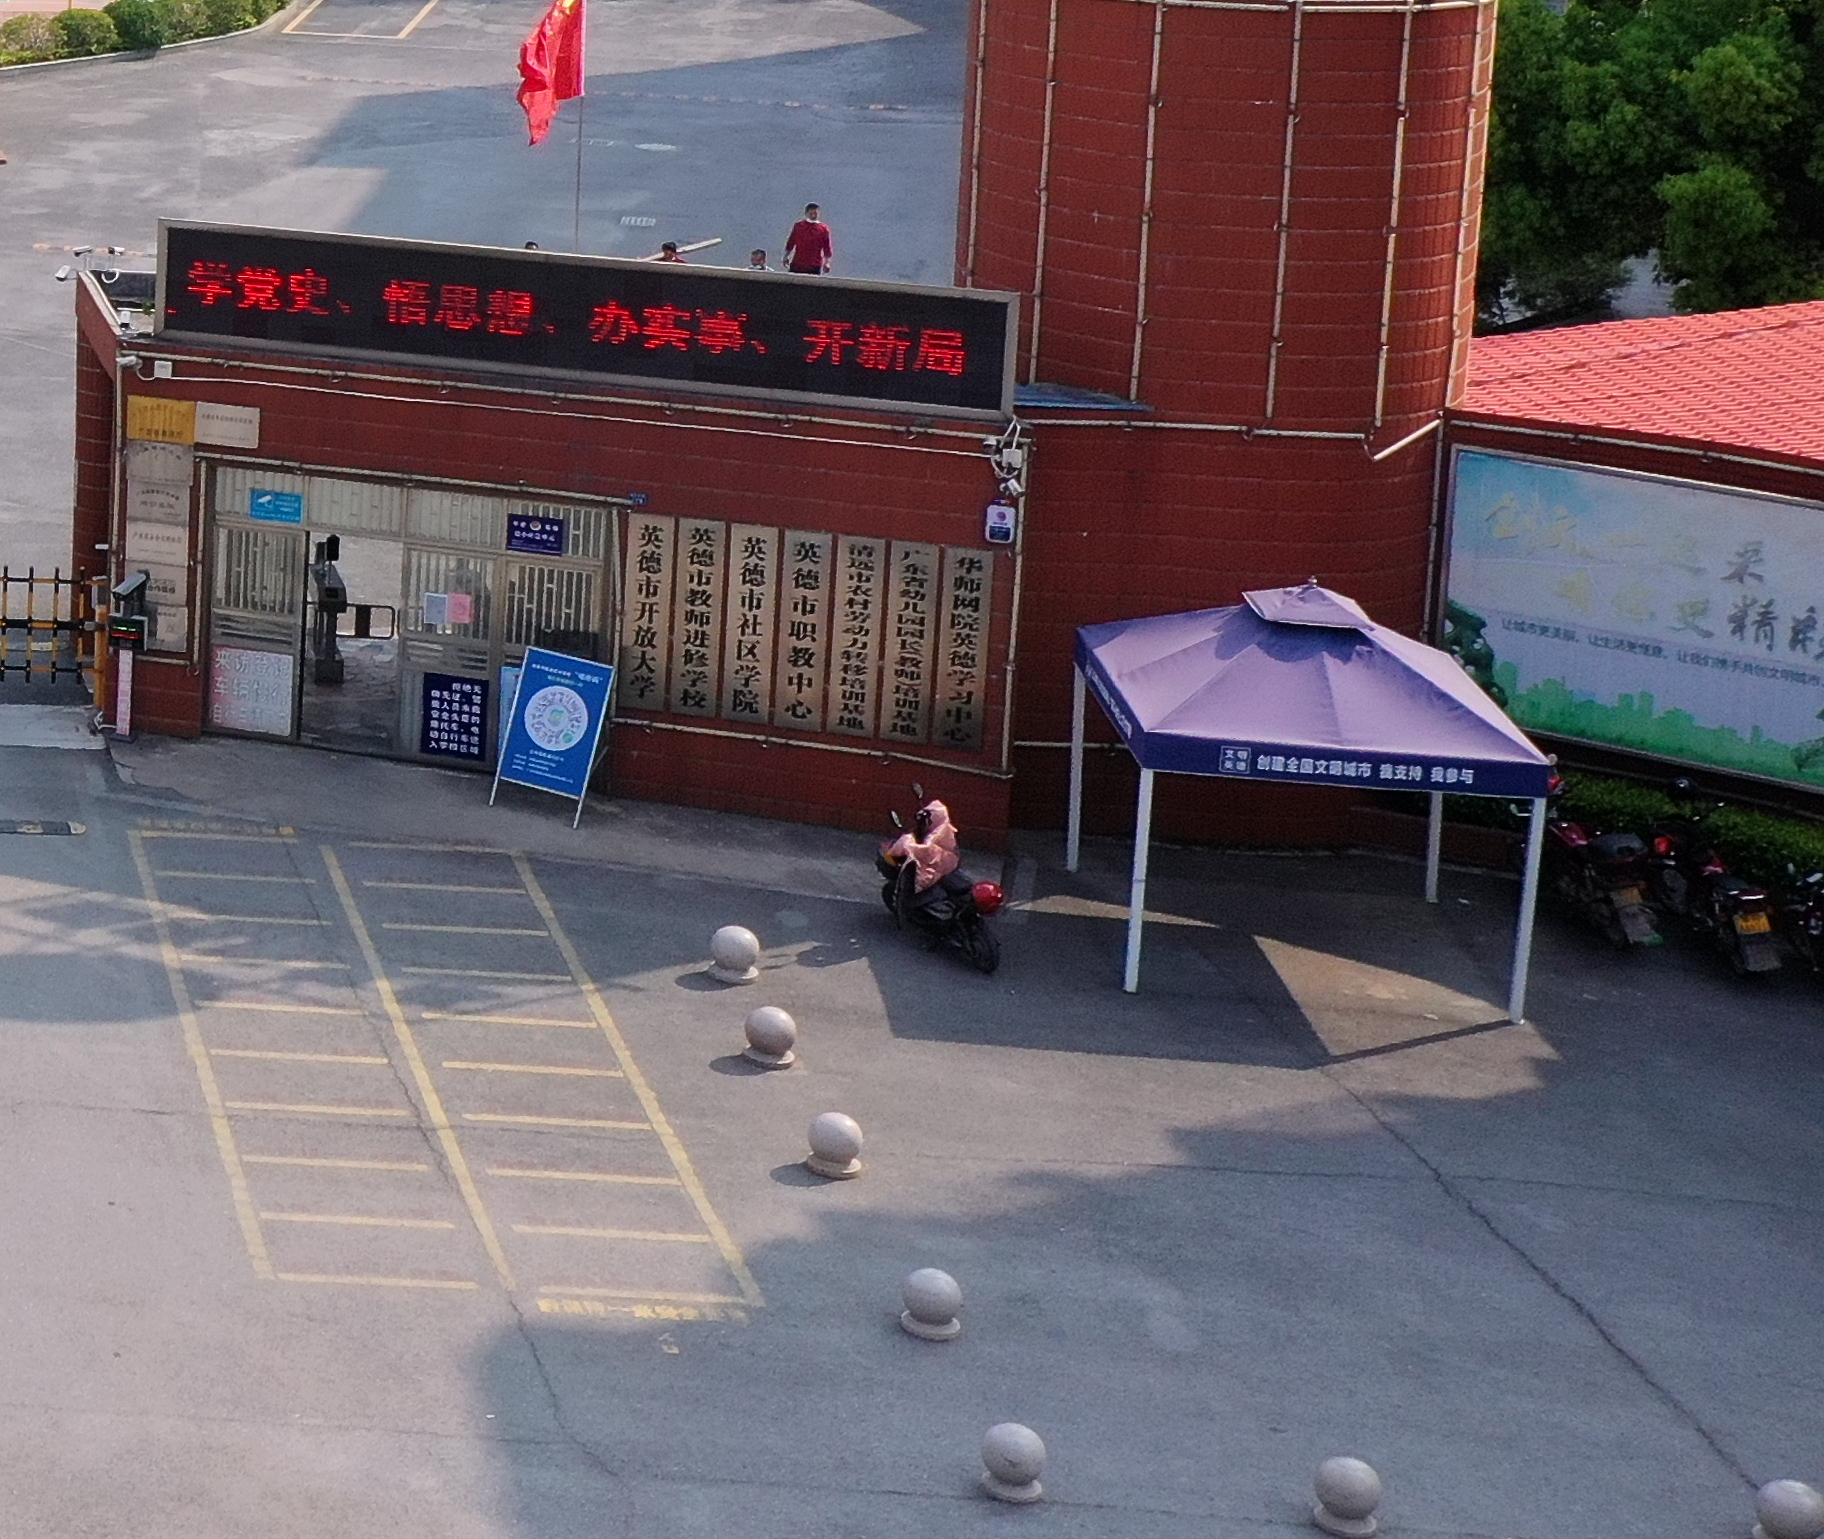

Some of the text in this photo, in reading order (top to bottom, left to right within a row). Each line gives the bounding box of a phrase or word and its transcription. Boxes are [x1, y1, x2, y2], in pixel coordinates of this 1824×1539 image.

[629, 524, 665, 699] 英德市开放大学
[679, 527, 716, 709] 英德市教师进修学校
[731, 536, 768, 714] 英德市社区学院
[784, 541, 822, 720] 英德市职教中心
[837, 543, 875, 730] 清远市农村劳动力转移培训基地
[942, 556, 984, 742] 华师网院英德学习中心
[1256, 754, 1475, 785] 创建全国文明城市 我支持 我参与
